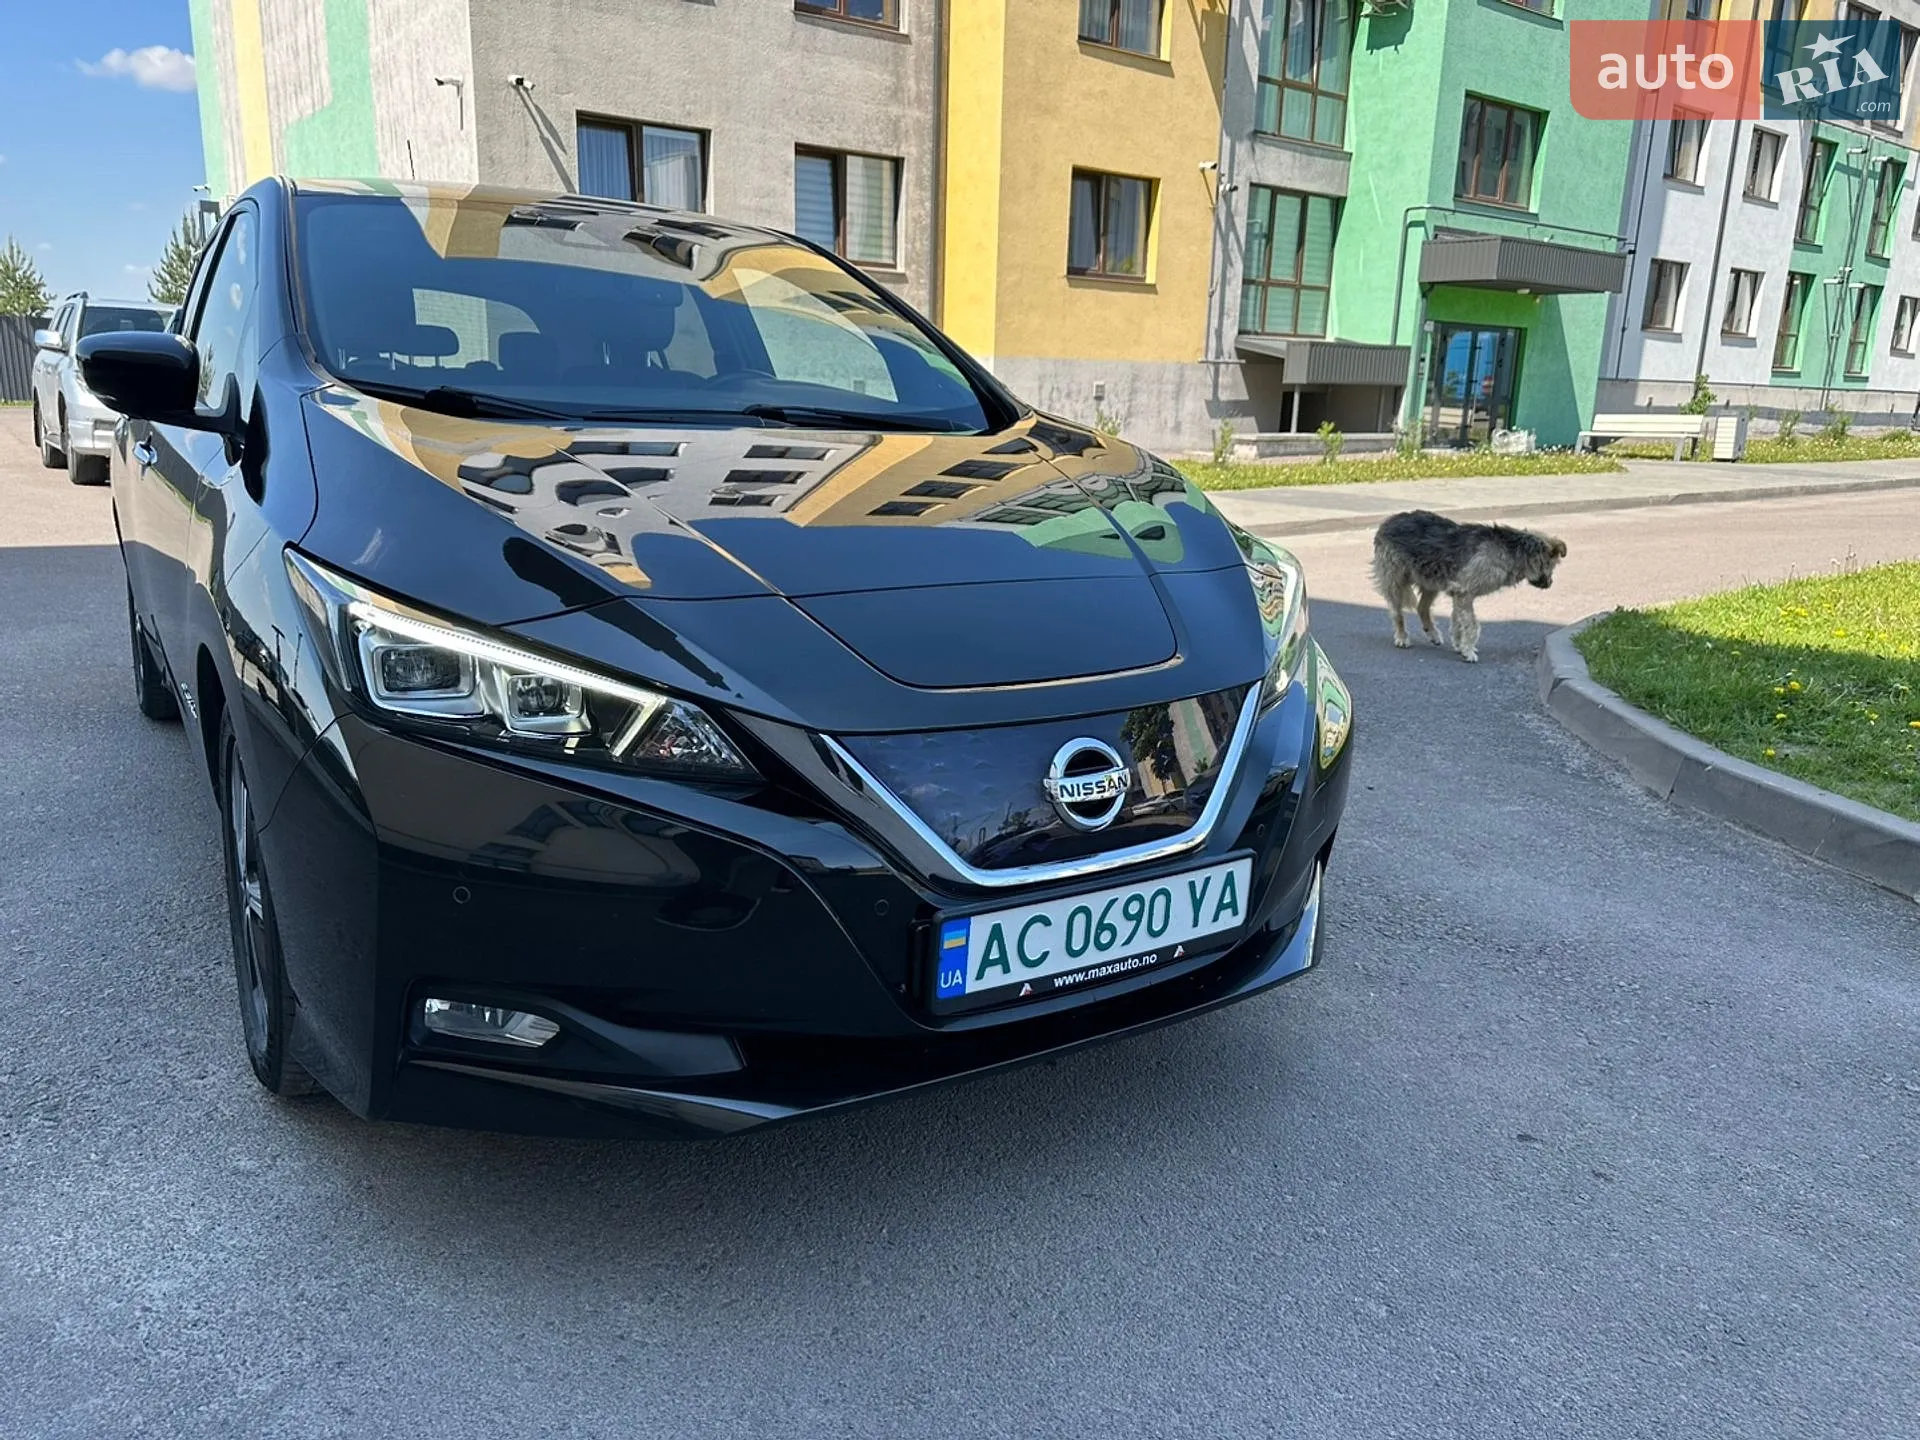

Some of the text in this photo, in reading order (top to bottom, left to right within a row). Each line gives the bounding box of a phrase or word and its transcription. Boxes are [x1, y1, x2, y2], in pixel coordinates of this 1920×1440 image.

[1059, 774, 1128, 798] NISSAN
[975, 870, 1240, 981] AC 0690 YA
[941, 968, 964, 989] UA
[1053, 953, 1158, 988] www.maxauto.no
